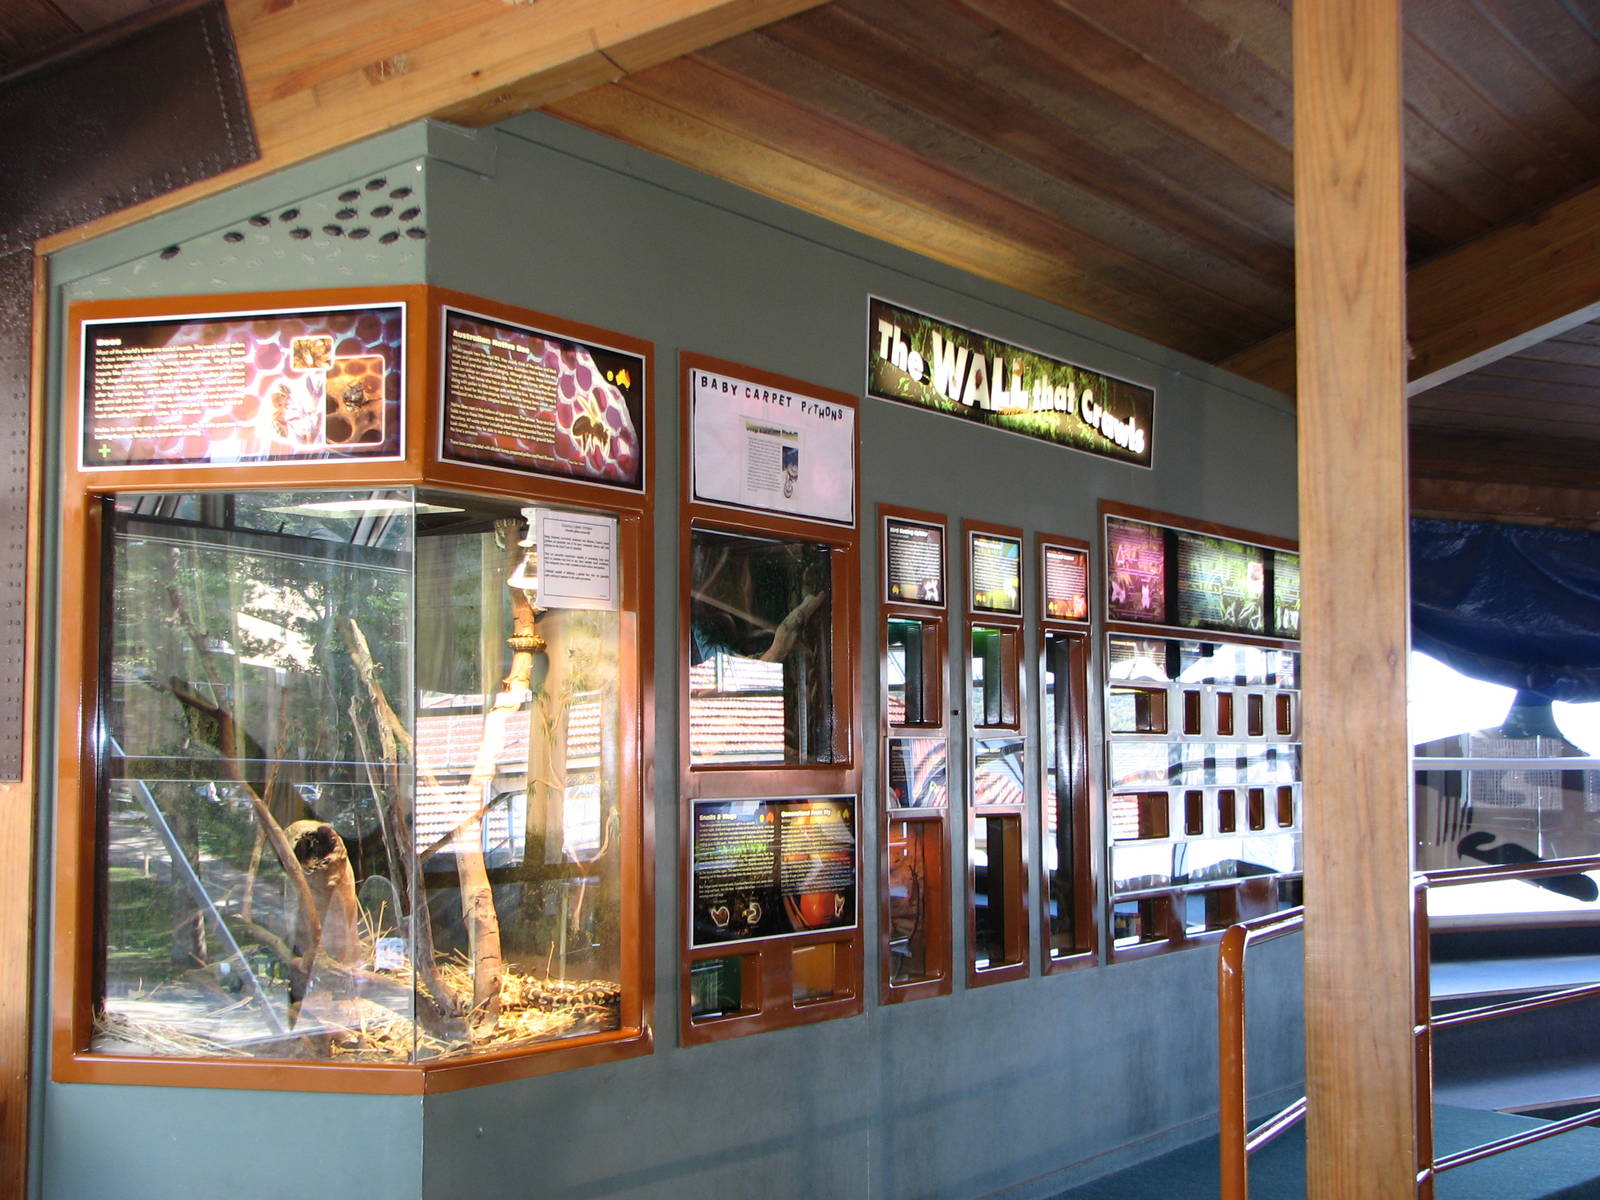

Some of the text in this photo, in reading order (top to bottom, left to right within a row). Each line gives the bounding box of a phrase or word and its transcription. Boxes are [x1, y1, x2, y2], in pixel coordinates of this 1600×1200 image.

[453, 330, 491, 345] Australian
[491, 338, 516, 351] Native
[701, 376, 738, 395] BABY
[745, 387, 792, 407] CARPET
[878, 319, 1145, 455] The WALL that Crawls
